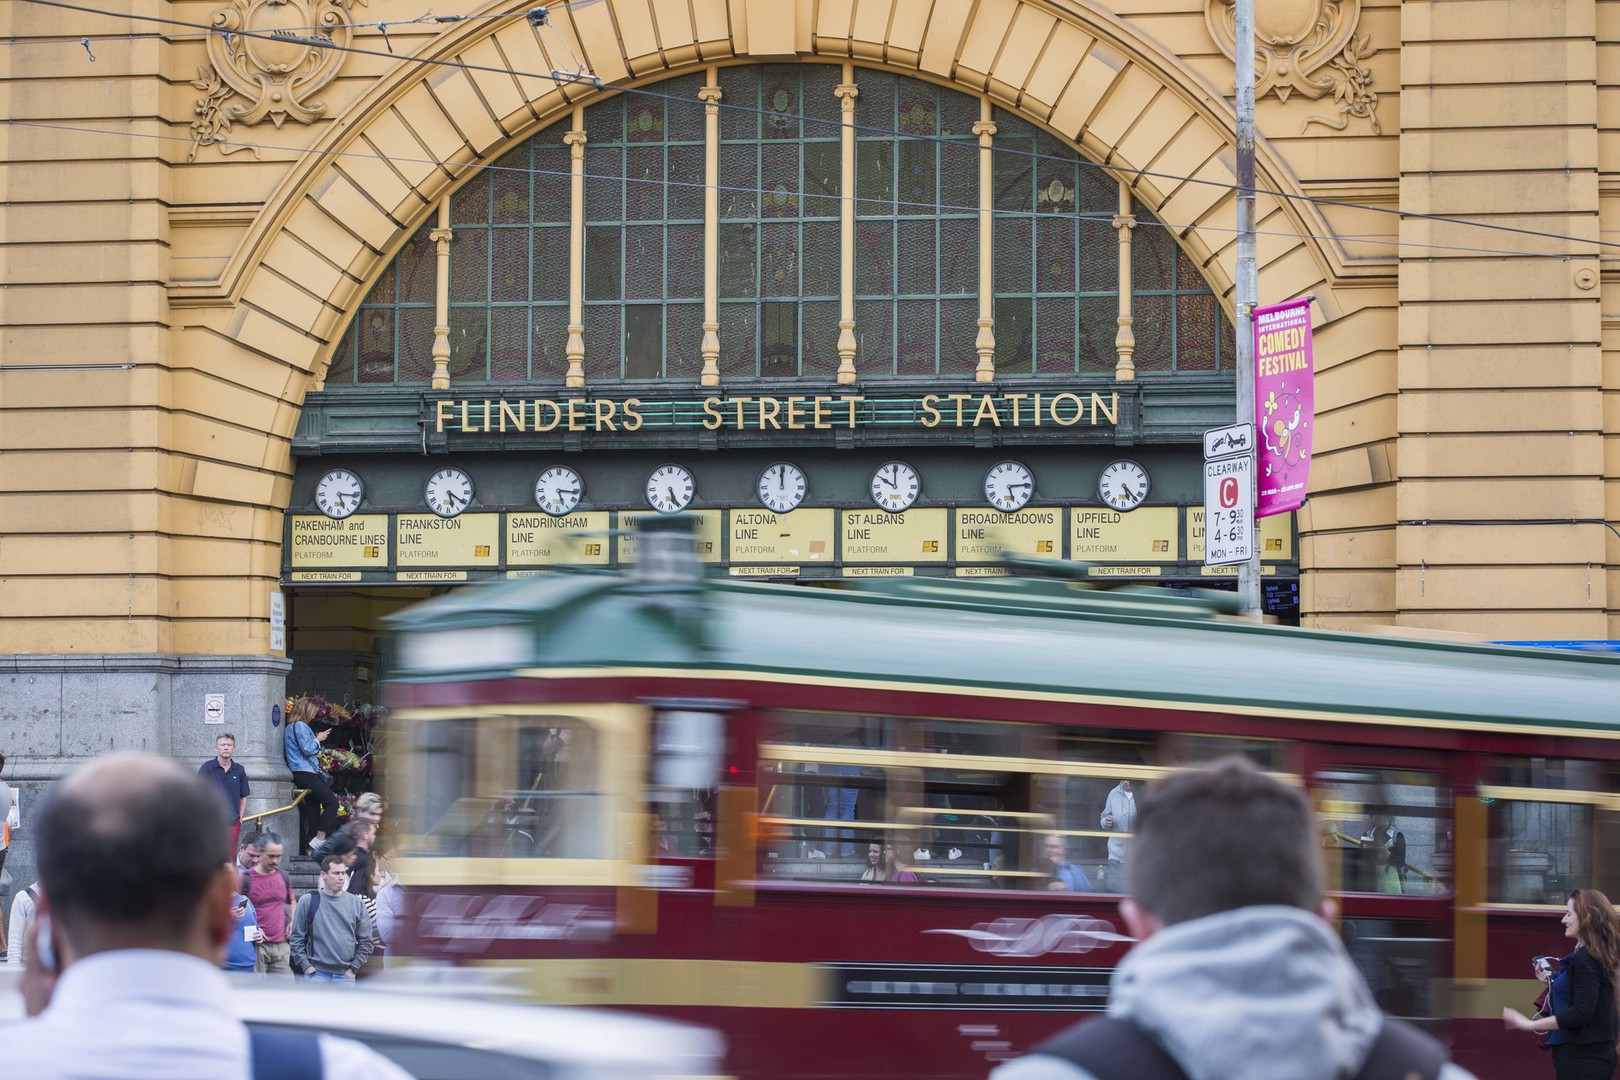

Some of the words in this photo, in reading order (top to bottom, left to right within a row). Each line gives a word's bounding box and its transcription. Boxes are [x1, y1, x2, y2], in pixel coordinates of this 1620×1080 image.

[1258, 306, 1306, 324] MELBOURNE
[1259, 317, 1306, 333] INTERNATIONAL
[1259, 326, 1306, 356] COMEDY
[1259, 350, 1308, 377] FESTIVAL
[436, 397, 643, 432] FLINDERS
[702, 396, 864, 431] STREET
[920, 392, 1118, 427] STATION
[1208, 461, 1249, 477] CLEARWAY
[1223, 480, 1234, 506] C
[512, 518, 588, 528] SANDRINGHAM
[736, 514, 777, 525] ALTONA
[848, 514, 861, 525] ST
[864, 514, 905, 525] ALBANS
[962, 513, 1054, 524] BROADMEADOWS
[1077, 513, 1121, 523] UPFIELD
[295, 521, 344, 531] PAKENHAM
[349, 521, 365, 531] and
[400, 519, 461, 529] FRANKSTON
[512, 533, 534, 543] LINE
[736, 529, 758, 539] LINE
[848, 529, 870, 540] LINE
[962, 529, 985, 539] LINE
[1077, 528, 1100, 538] LINE
[295, 535, 357, 545] CRANBOURNE
[360, 535, 386, 545] LINES
[400, 534, 422, 544] LINE
[705, 542, 712, 553] 9
[931, 541, 938, 552] 5
[1046, 541, 1053, 552] 5
[1275, 539, 1282, 551] 9
[372, 546, 379, 558] 6
[1211, 549, 1226, 559] MON
[1235, 546, 1247, 556] FRI
